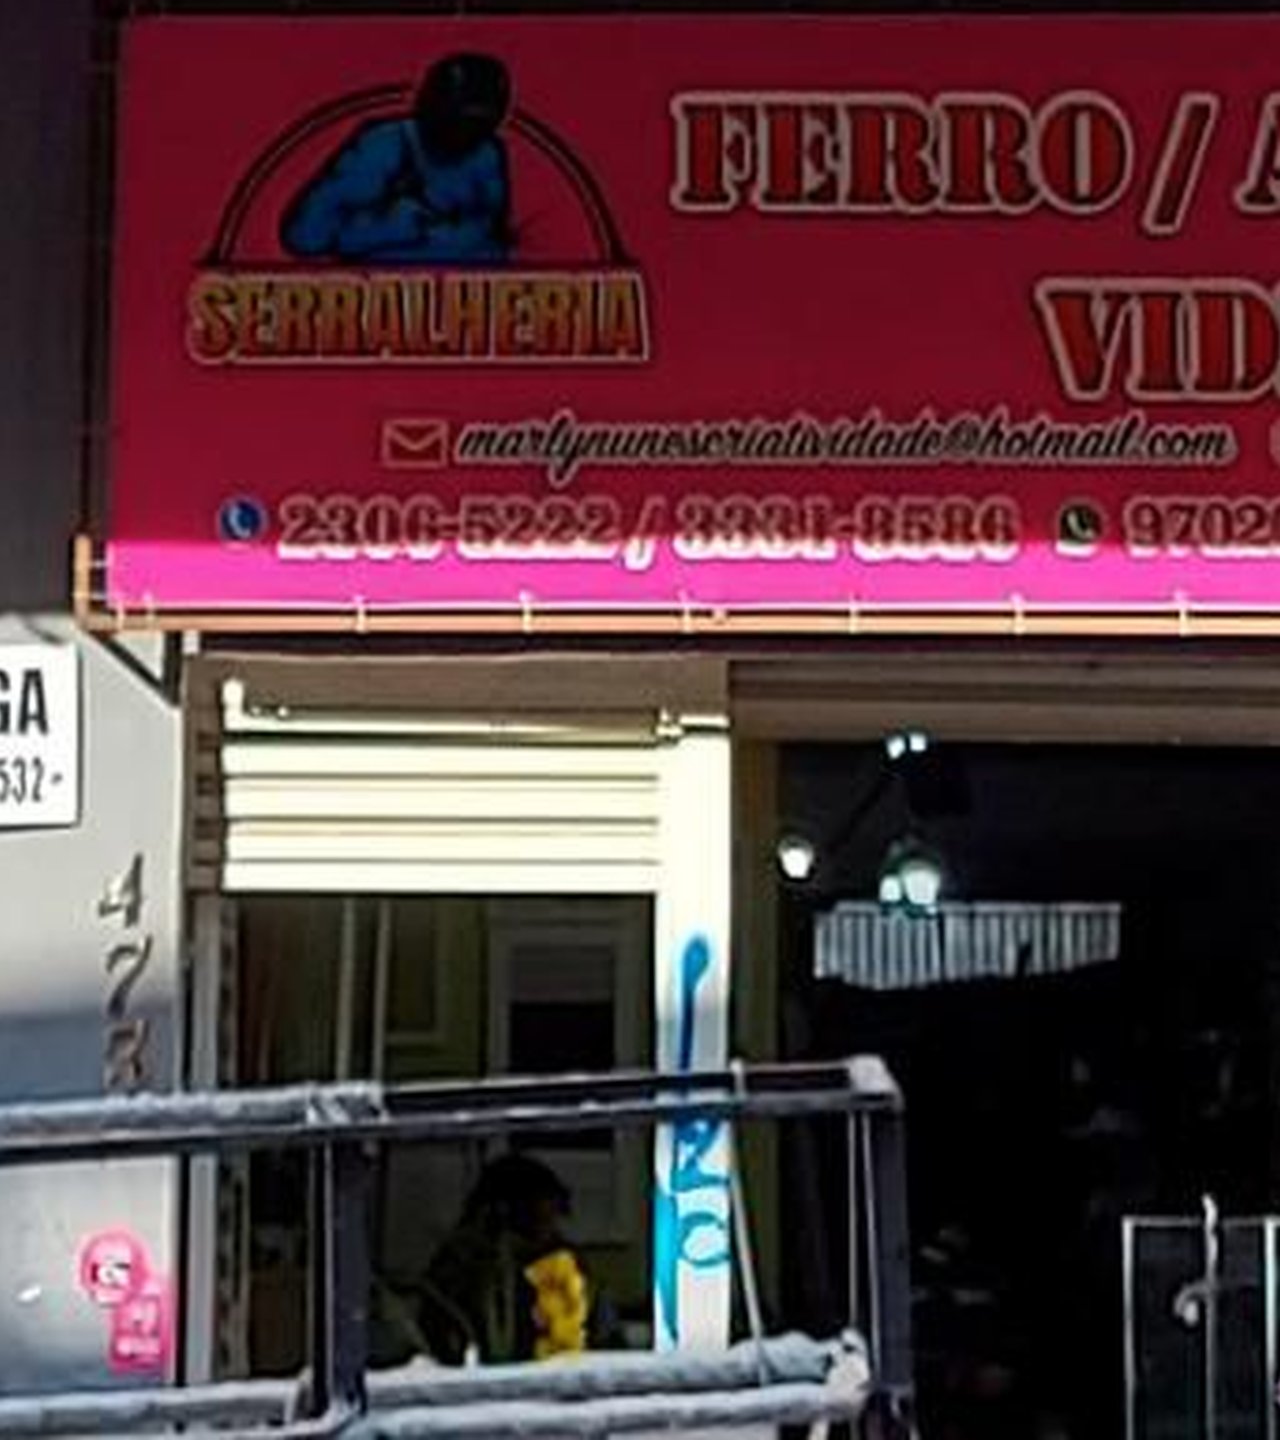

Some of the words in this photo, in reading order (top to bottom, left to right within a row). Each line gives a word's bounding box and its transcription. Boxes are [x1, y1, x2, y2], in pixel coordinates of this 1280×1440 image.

[670, 91, 1132, 214] FERRO
[1142, 92, 1220, 235] /
[188, 270, 650, 364] SERRALHERIA
[275, 494, 618, 560] 2306-5222
